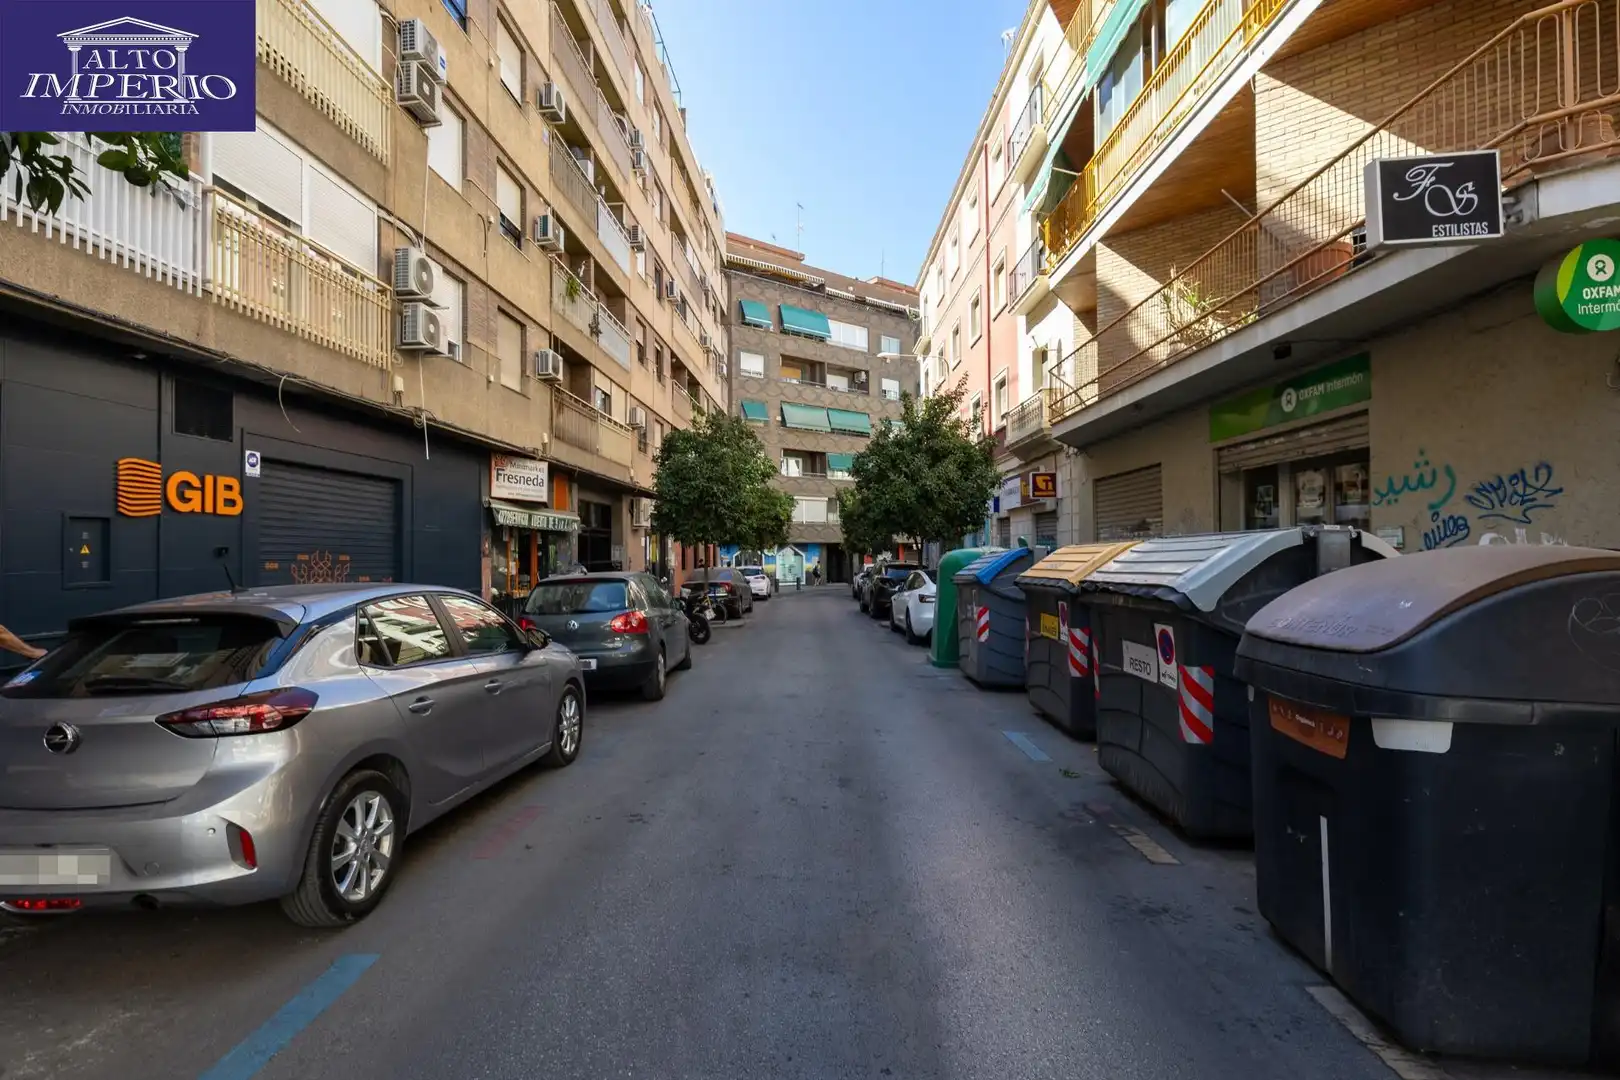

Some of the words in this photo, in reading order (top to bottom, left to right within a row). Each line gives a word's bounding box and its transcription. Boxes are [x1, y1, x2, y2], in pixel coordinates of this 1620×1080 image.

[1432, 221, 1489, 238] ESTILISTAS
[1577, 299, 1620, 315] Intermó
[1299, 383, 1325, 400] OXFAM
[495, 468, 545, 488] Fresneda
[166, 470, 243, 515] GIB
[1129, 656, 1151, 676] RESTO
